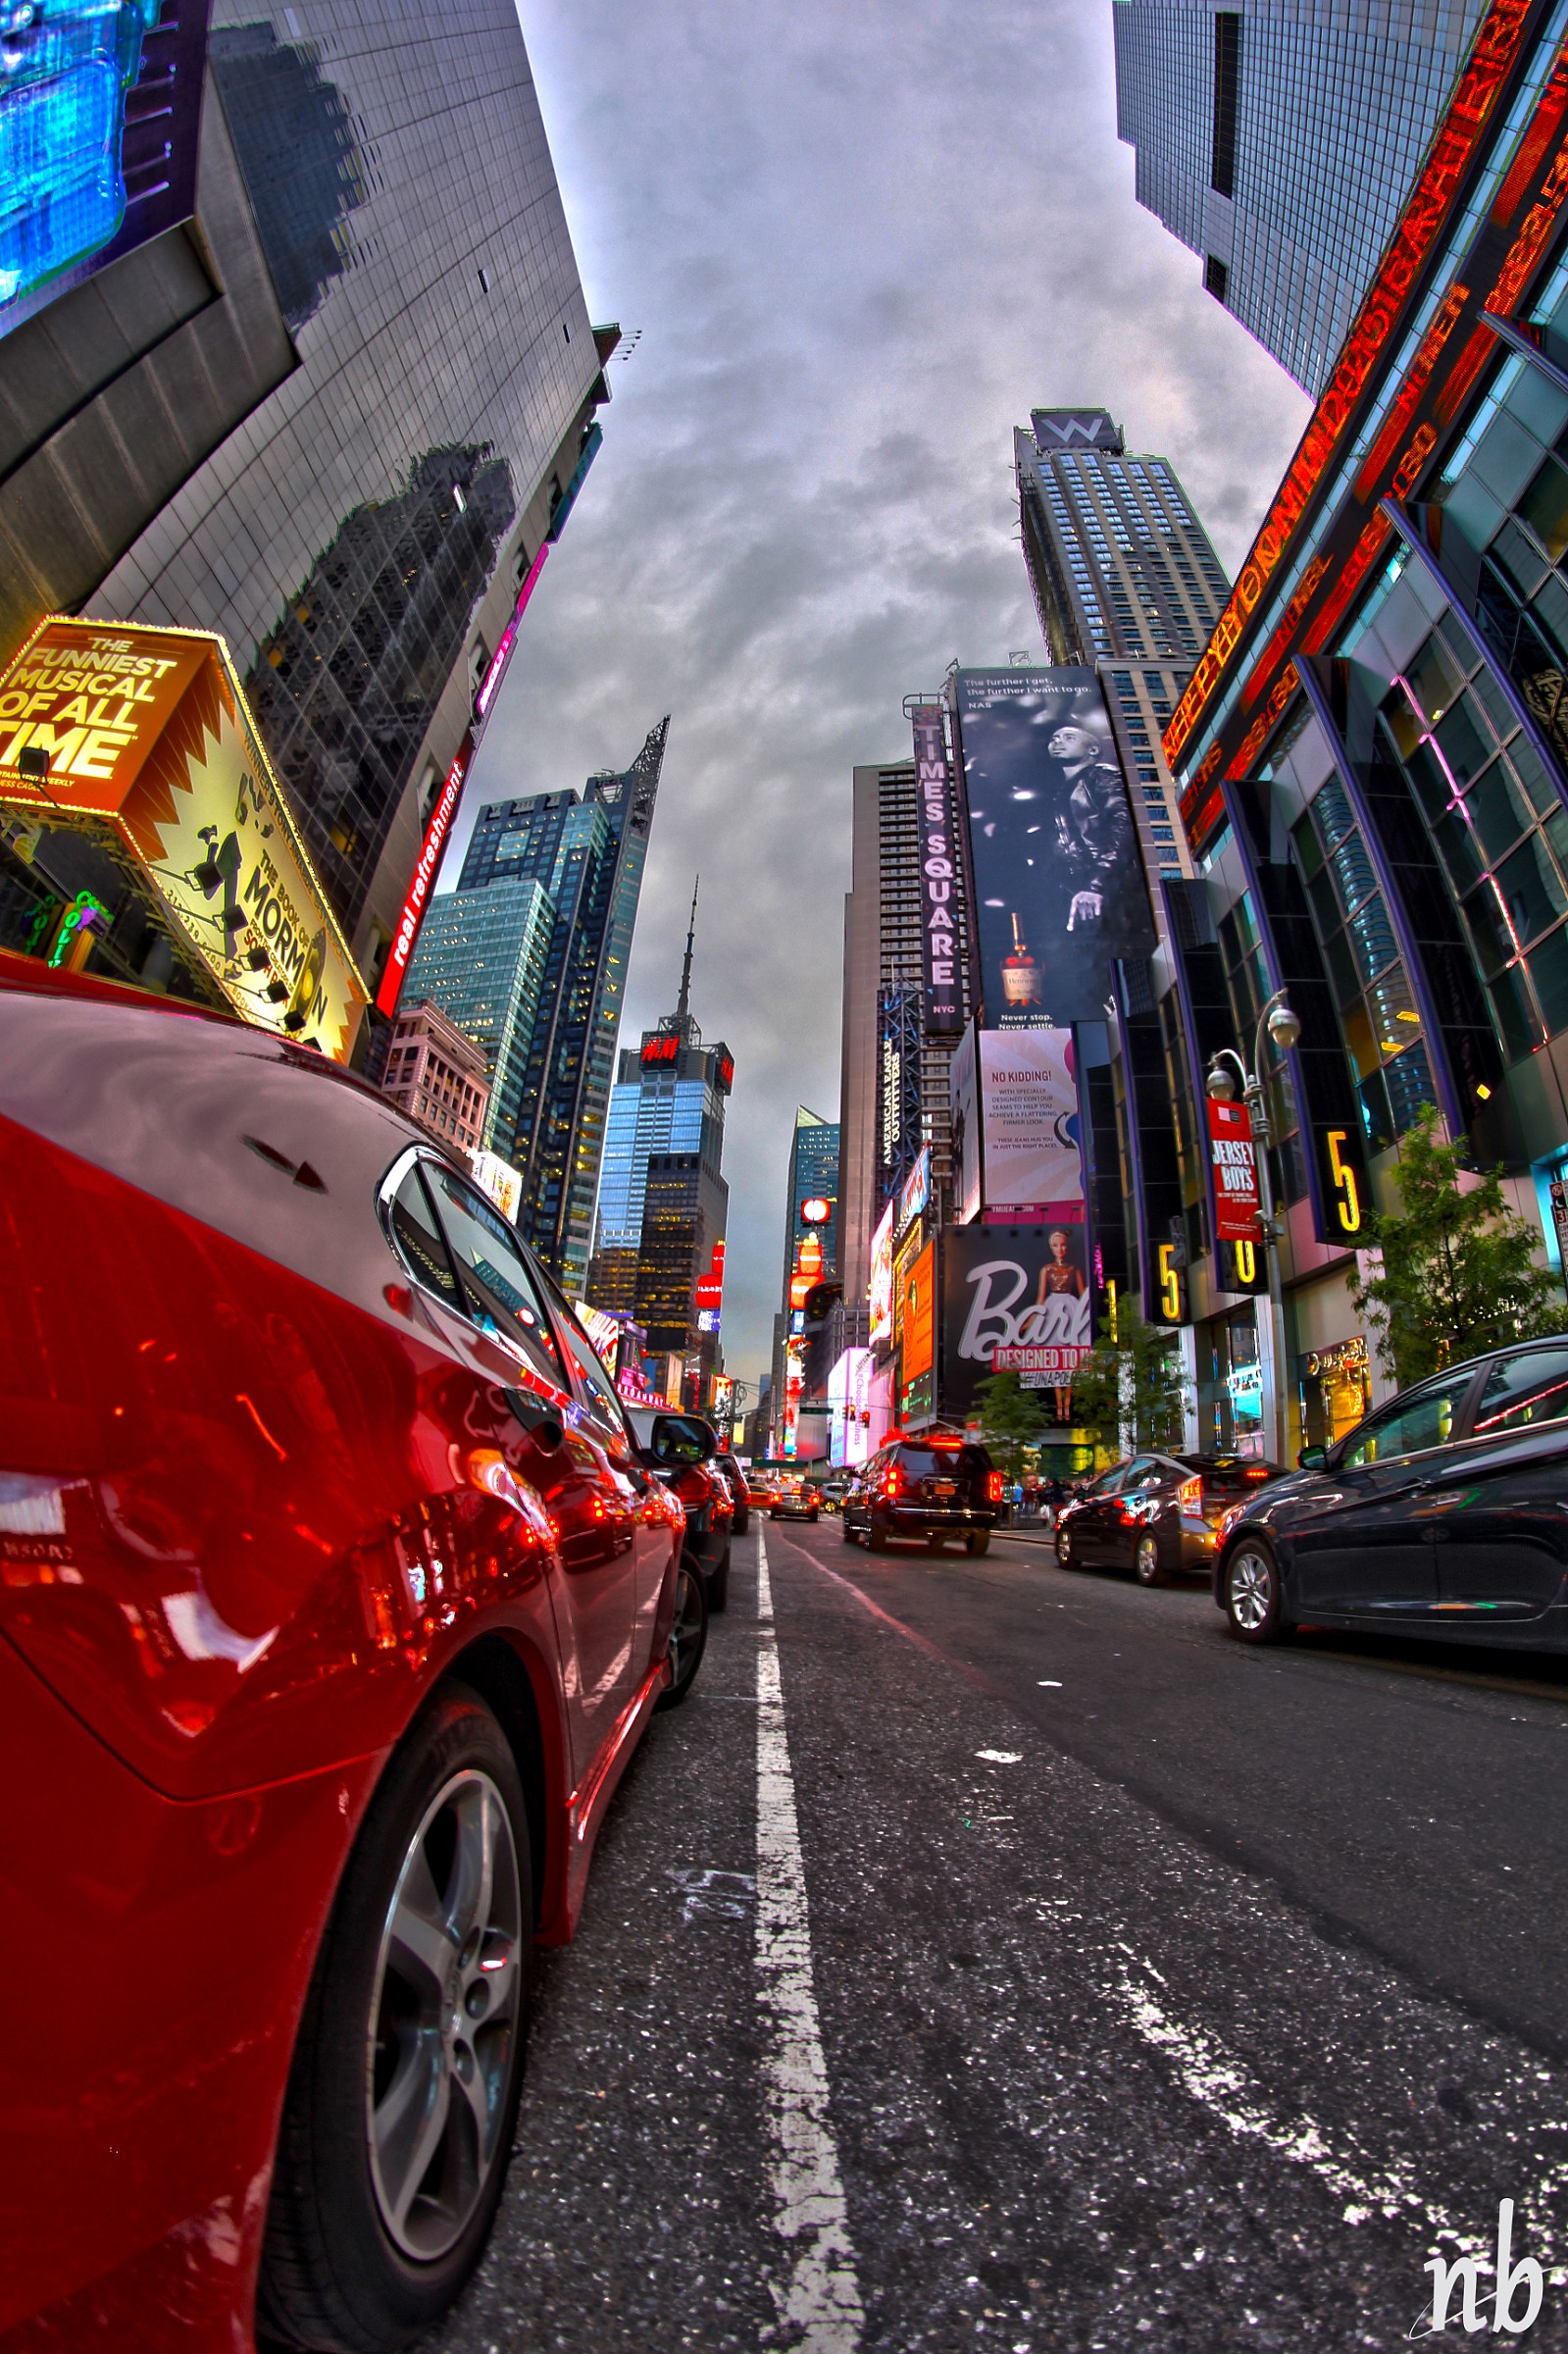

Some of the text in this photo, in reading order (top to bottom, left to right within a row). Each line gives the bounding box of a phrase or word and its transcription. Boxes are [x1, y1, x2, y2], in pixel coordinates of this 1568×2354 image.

[1040, 419, 1103, 442] W
[25, 648, 177, 679] FUNNIEST
[8, 668, 156, 702] MUSICAL
[0, 691, 138, 732] OF ALL
[394, 761, 464, 967] real refreshment
[916, 724, 955, 985] TIMES SQUARE
[260, 848, 310, 949] THE BOOK OF
[244, 928, 273, 979] SOH
[933, 1004, 956, 1014] NYC
[991, 1070, 1052, 1083] NO KIDDING!
[891, 1051, 900, 1143] OUTFITTERS
[1212, 1140, 1255, 1166] JERSEY
[1220, 1166, 1255, 1192] BOYS
[1327, 1131, 1360, 1232] 5
[1159, 1244, 1181, 1319] 5
[996, 1349, 1059, 1370] DESIGNED
[1062, 1349, 1078, 1369] TO
